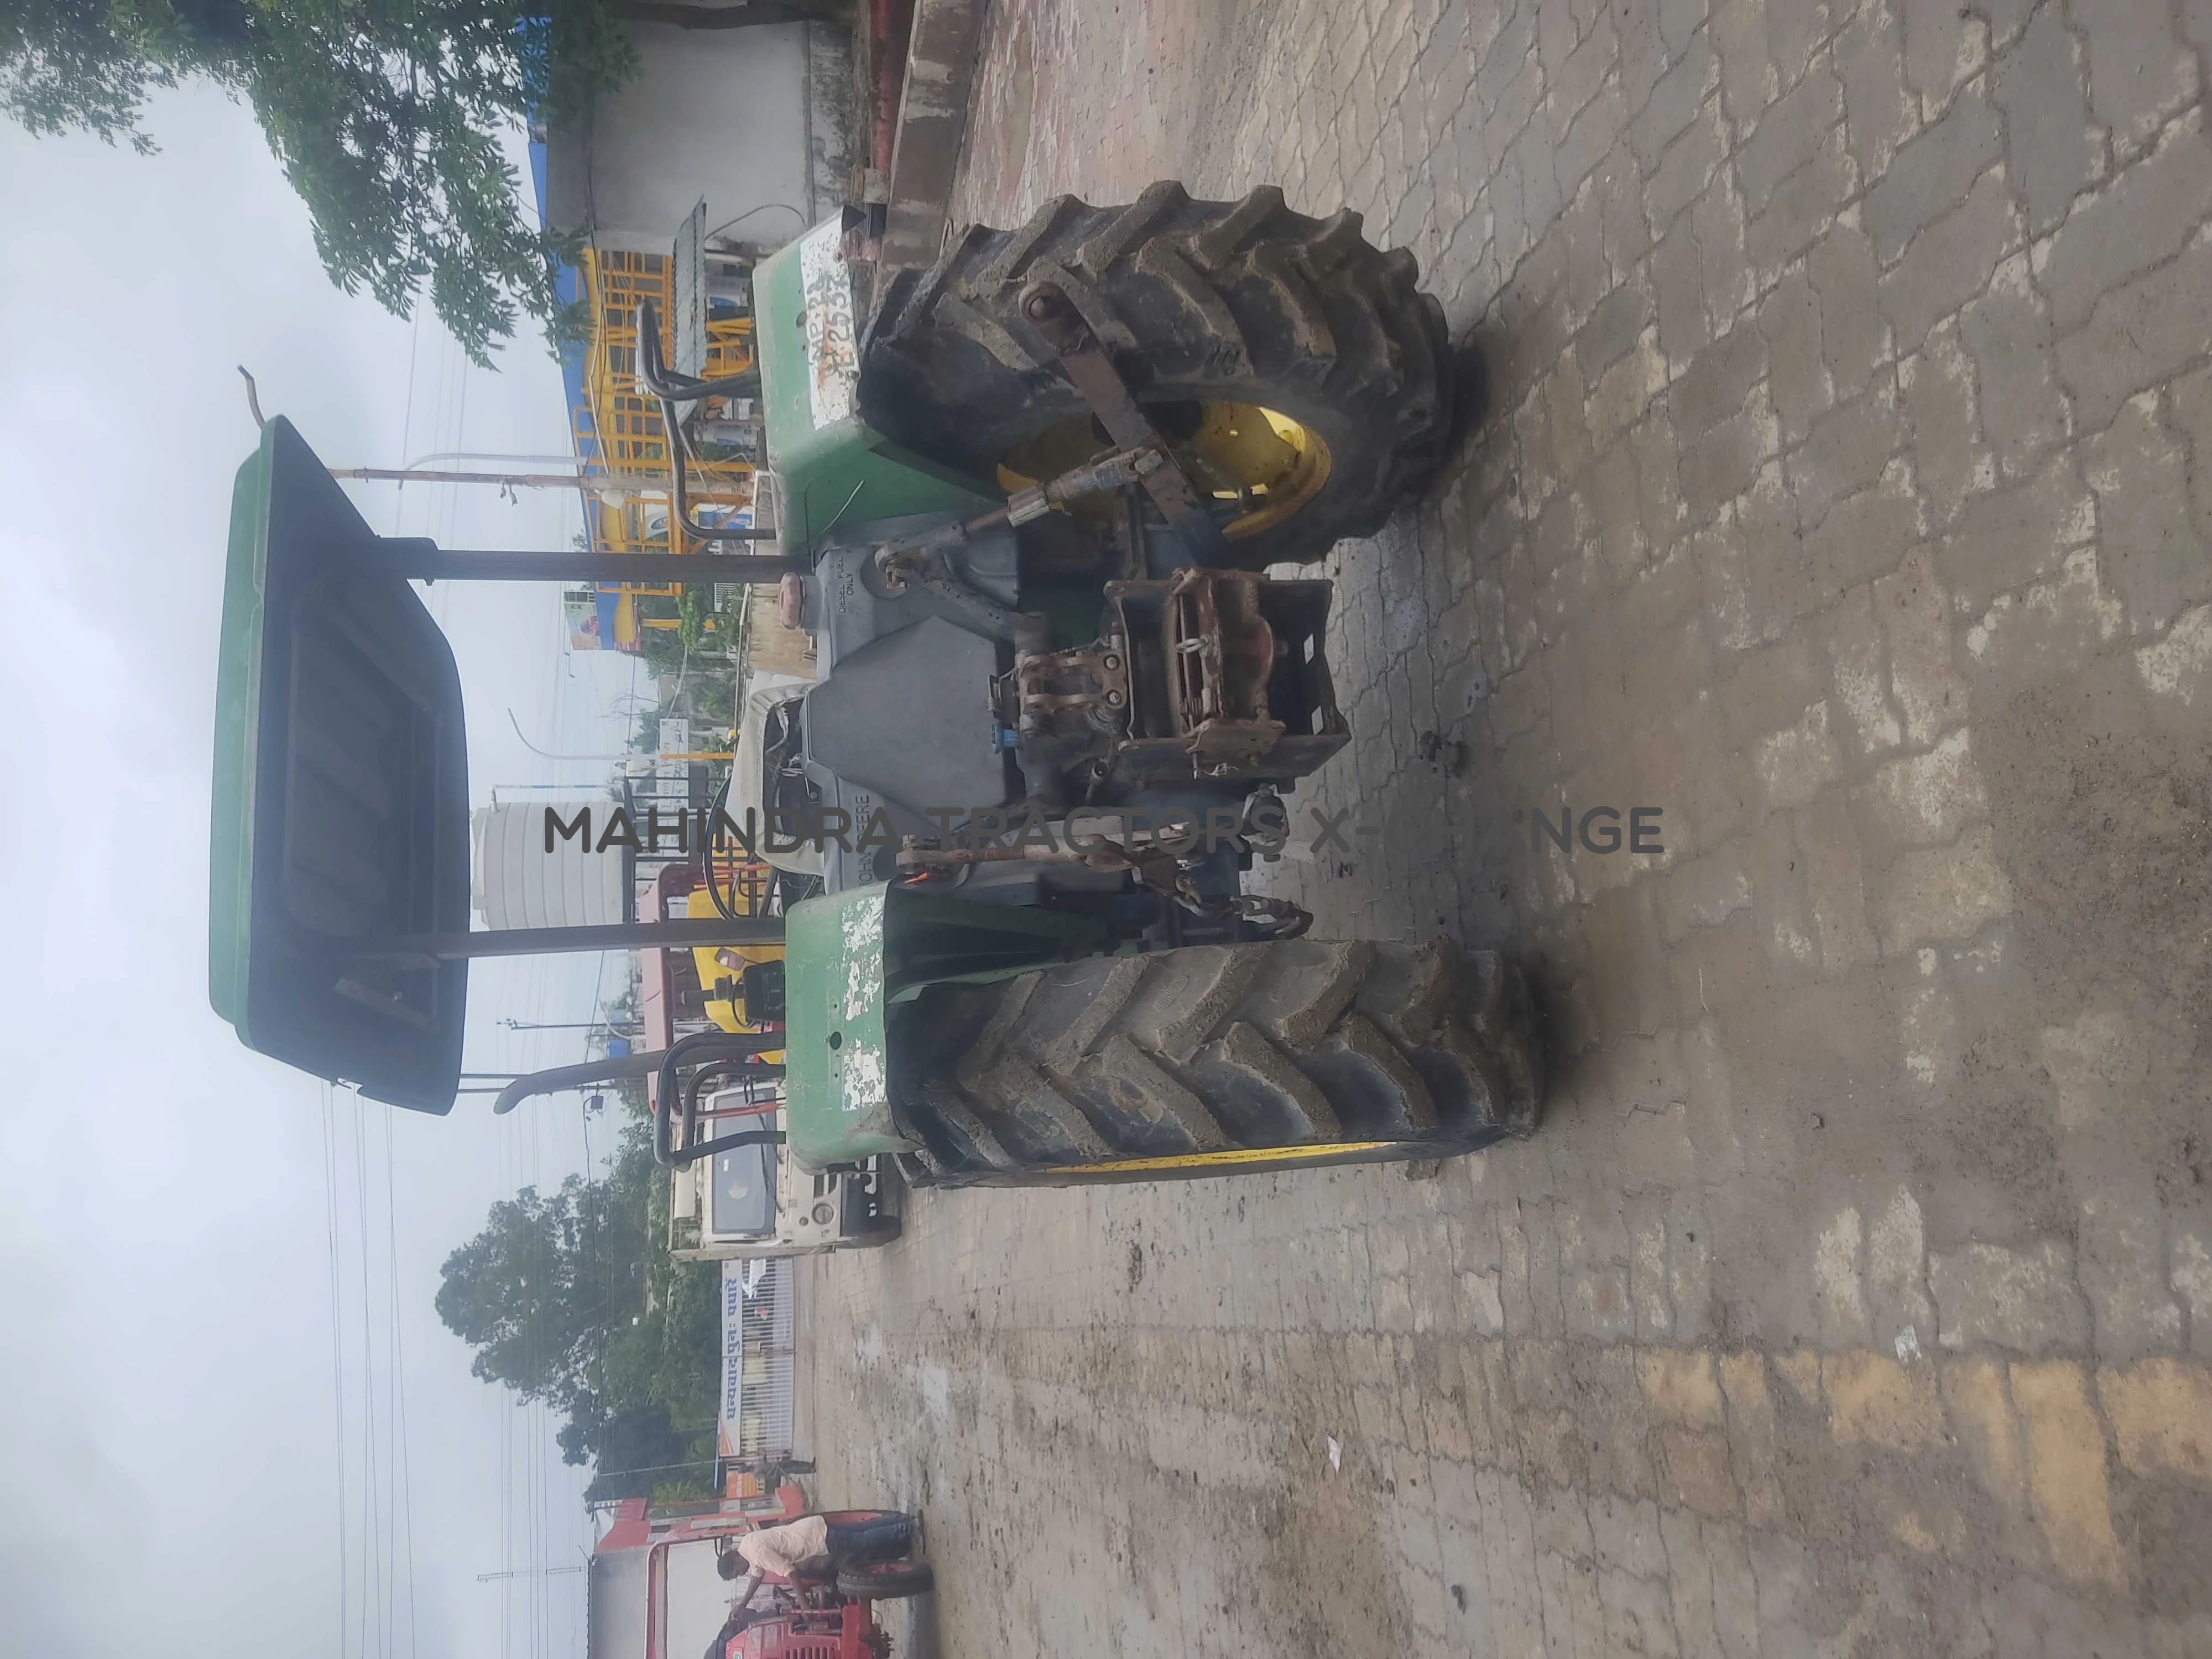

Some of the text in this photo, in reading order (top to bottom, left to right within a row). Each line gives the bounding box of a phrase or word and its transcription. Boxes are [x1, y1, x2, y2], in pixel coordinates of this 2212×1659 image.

[836, 557, 846, 613] DIESEL FUEL
[846, 573, 854, 596] ONLY
[858, 852, 873, 885] OHN
[725, 1278, 737, 1317] पधारें
[726, 1357, 738, 1419] धन्यवाद
